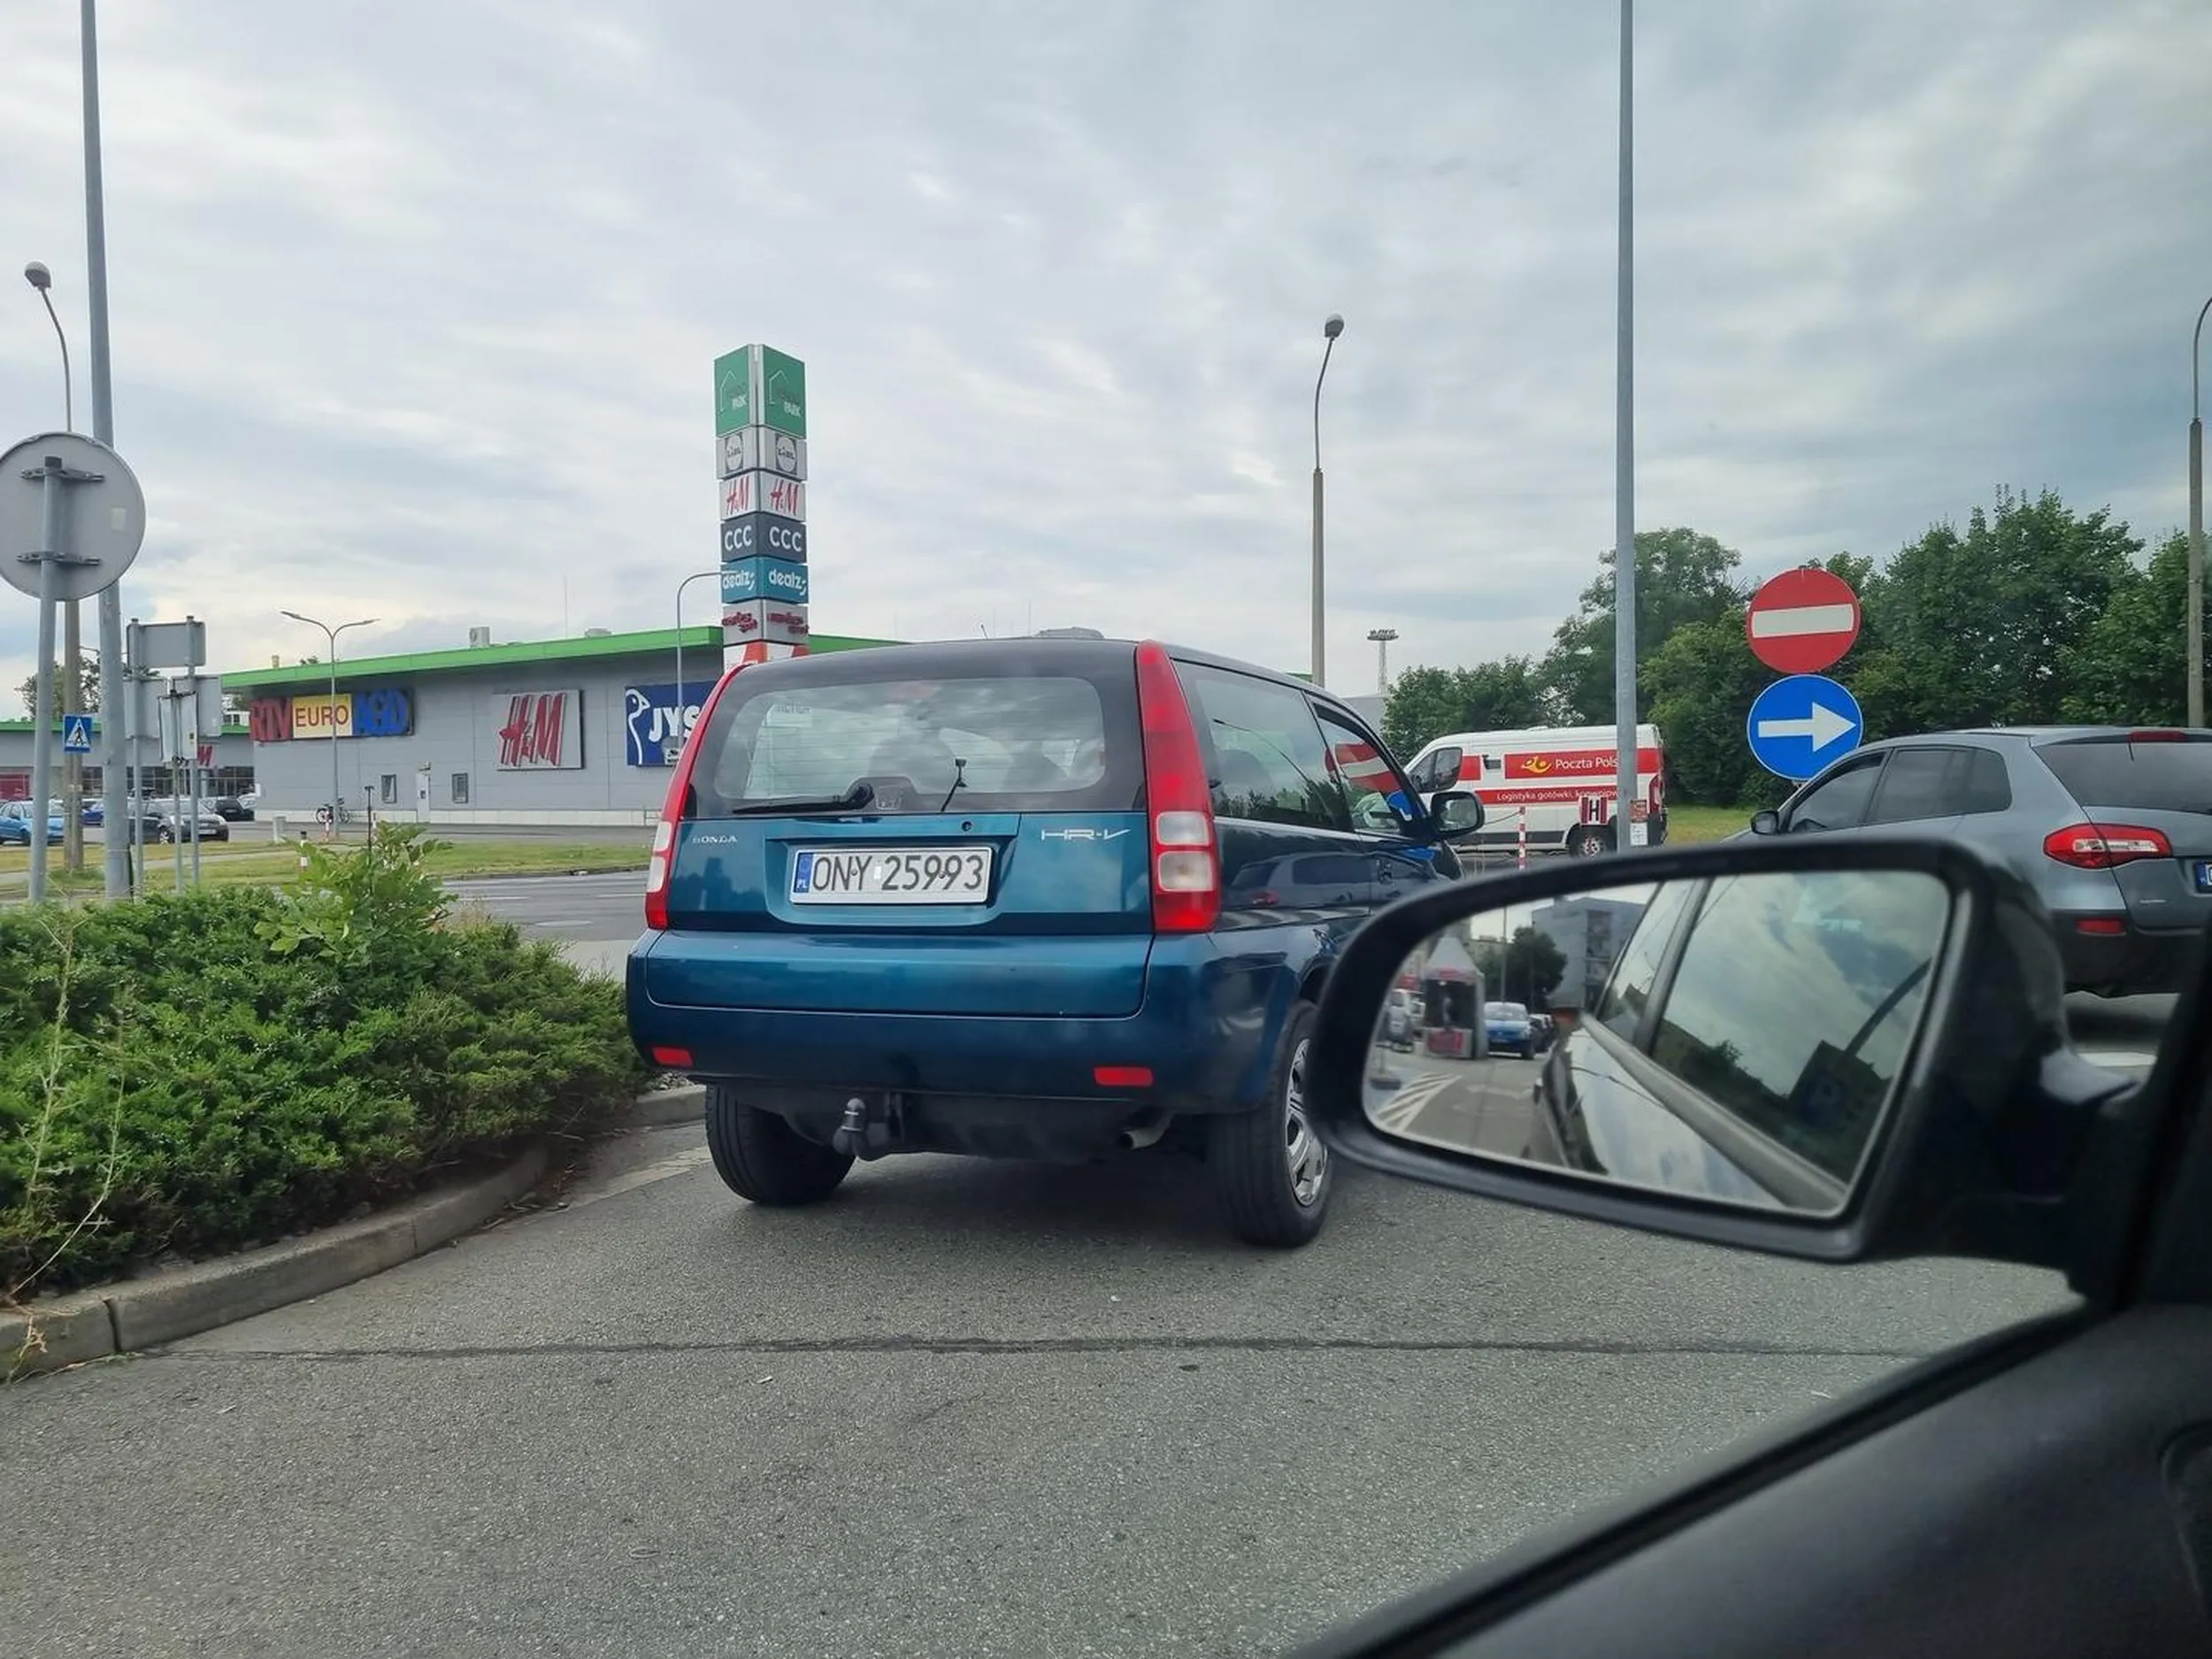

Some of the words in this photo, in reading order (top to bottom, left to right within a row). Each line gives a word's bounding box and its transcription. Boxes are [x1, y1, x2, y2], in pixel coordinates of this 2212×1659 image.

[770, 478, 799, 516] H&M
[724, 525, 752, 550] CCC
[769, 526, 803, 552] CCC
[296, 704, 349, 727] EURO
[649, 705, 703, 742] JYS
[499, 693, 566, 766] H&M
[1555, 757, 1593, 770] Poczta
[1595, 757, 1618, 769] Pols
[691, 834, 737, 843] HONDA
[1041, 829, 1131, 841] HR-V
[813, 856, 873, 891] ONY
[881, 855, 984, 891] 25993
